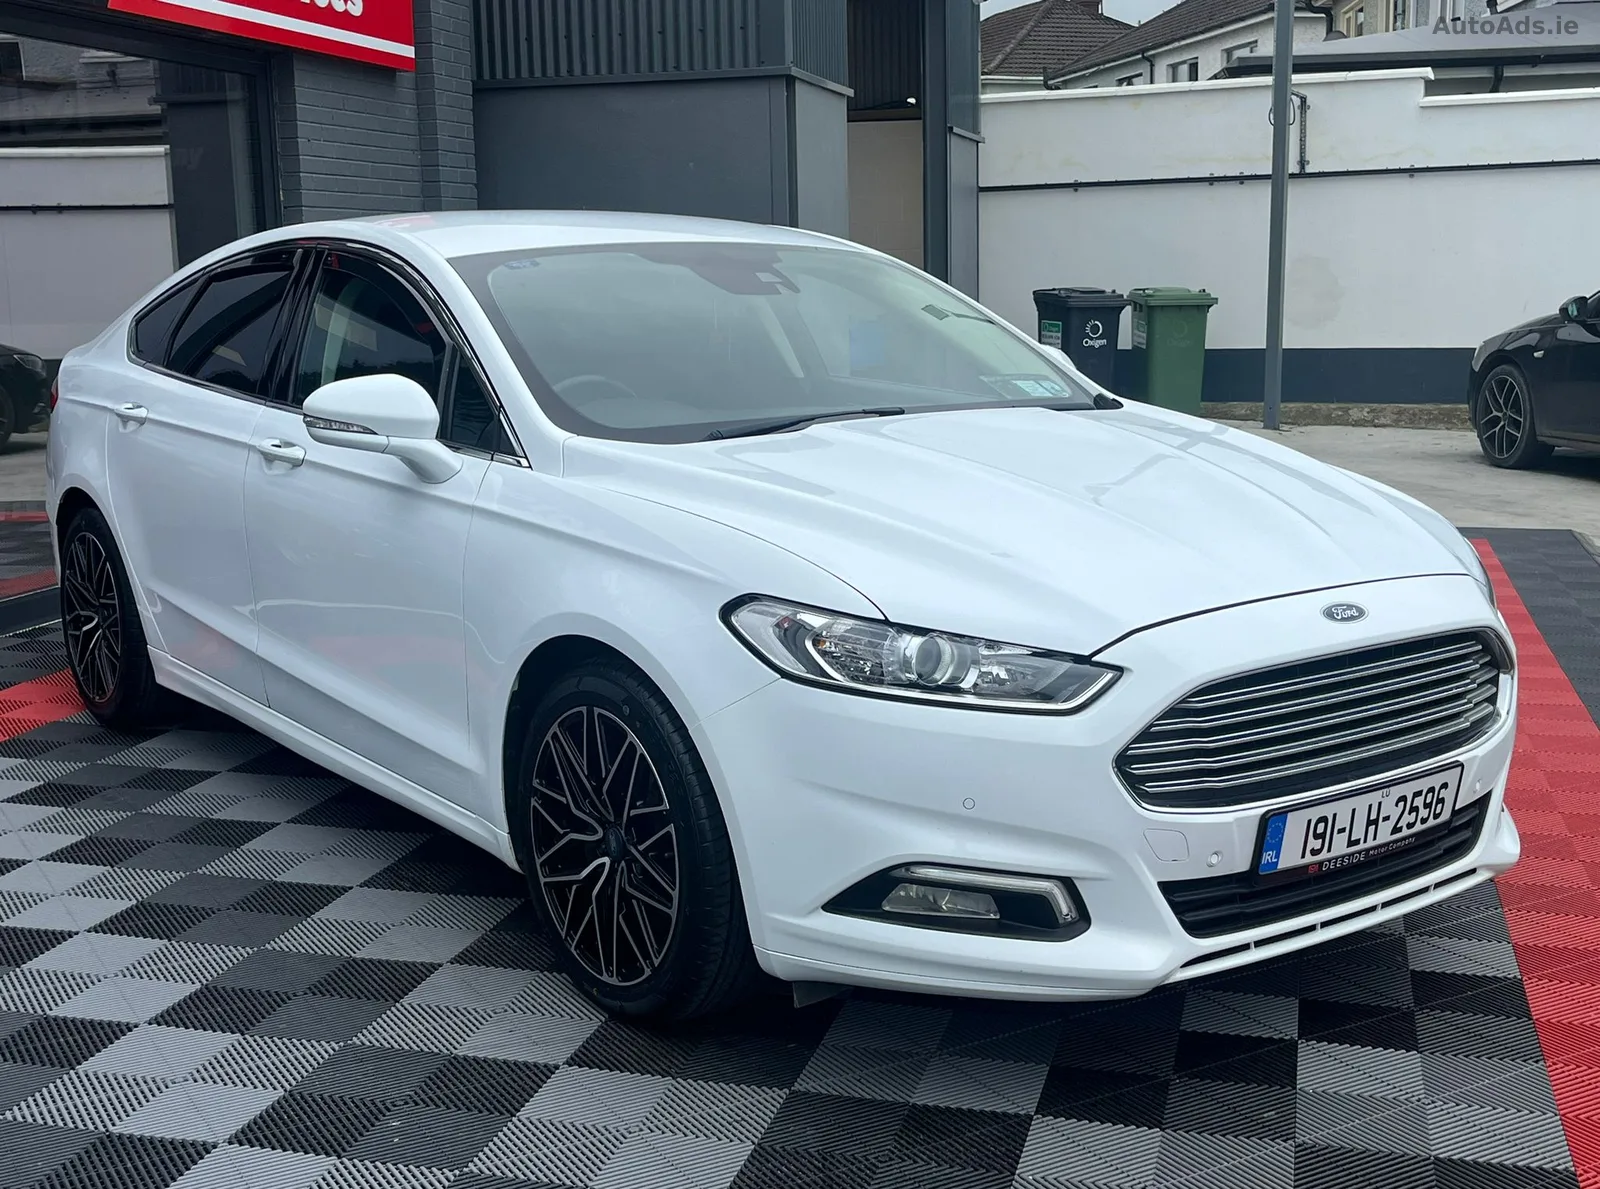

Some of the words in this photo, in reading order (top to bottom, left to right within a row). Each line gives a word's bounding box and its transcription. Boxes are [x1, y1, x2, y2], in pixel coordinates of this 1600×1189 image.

[1082, 338, 1107, 349] Oxigen
[1332, 605, 1359, 619] Ford
[1301, 781, 1449, 859] 191-LH-2596
[1261, 850, 1278, 865] IRL
[1322, 851, 1366, 871] DEESIDE
[1368, 846, 1388, 856] Motor
[1388, 836, 1416, 851] Company
